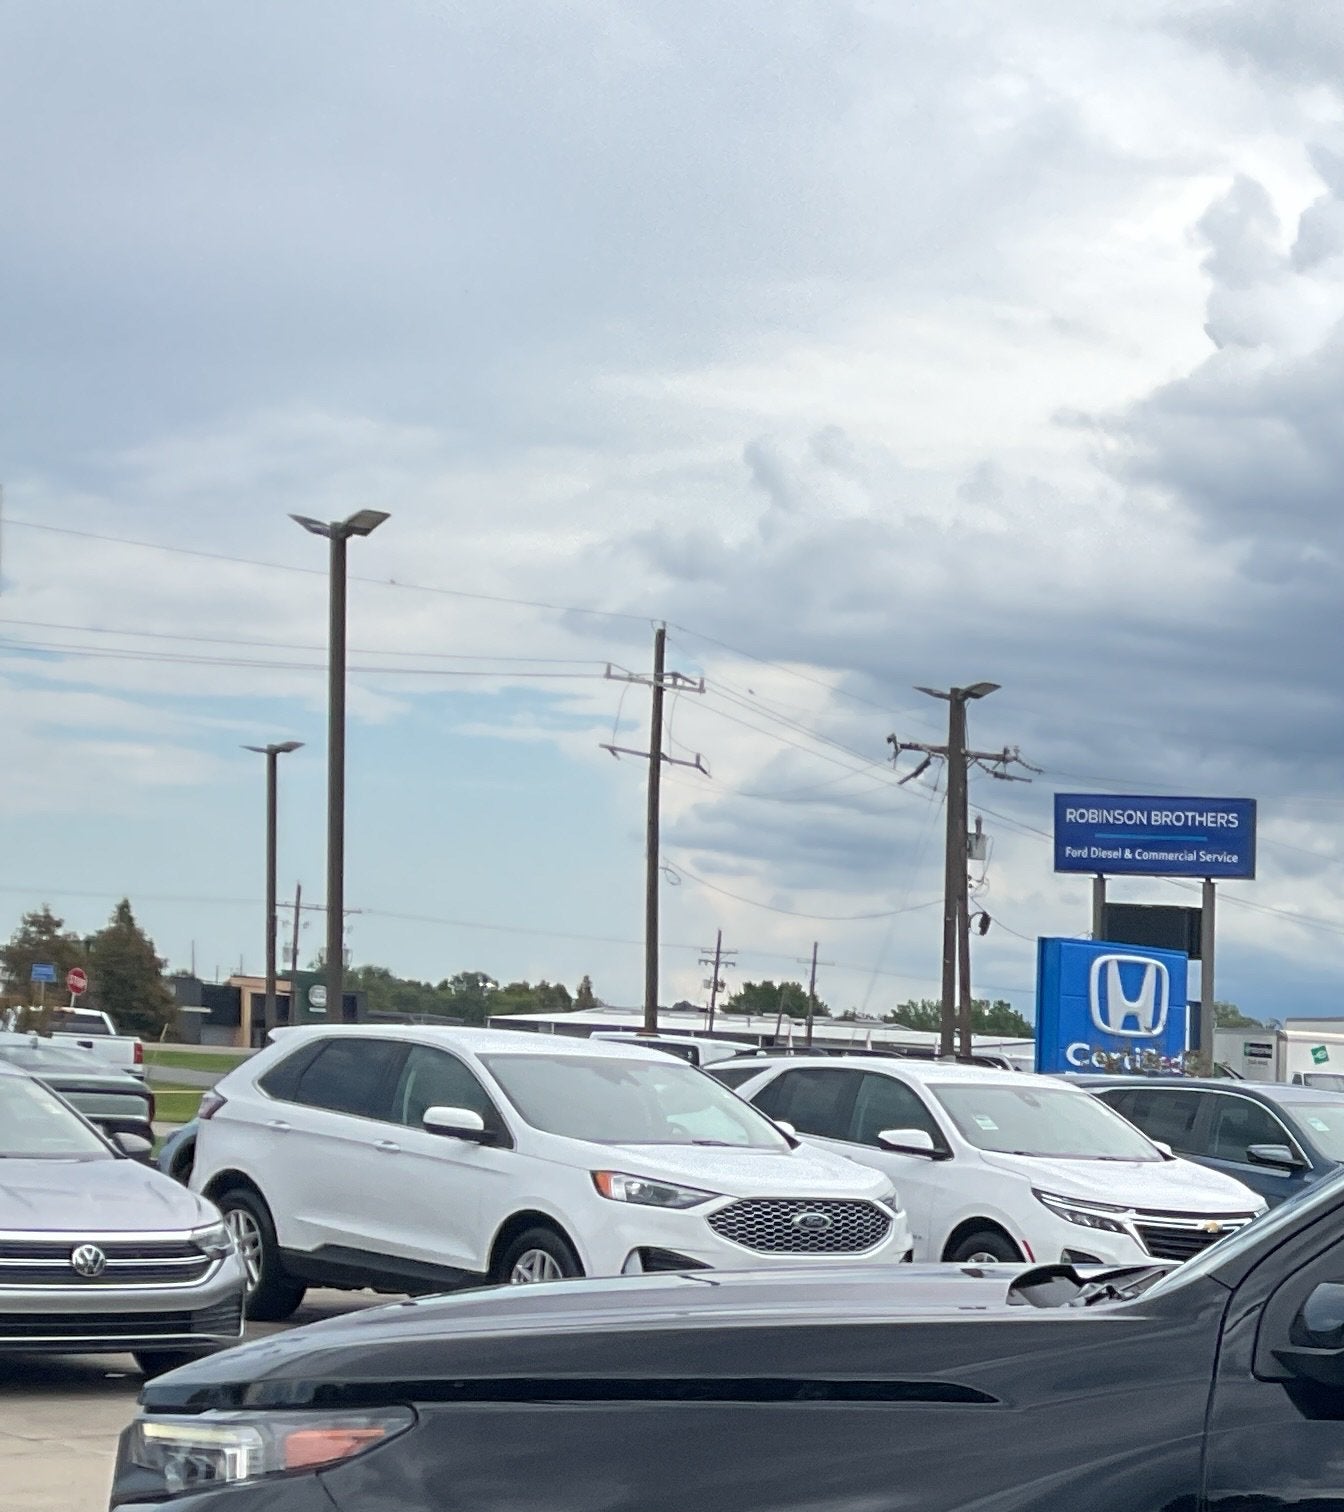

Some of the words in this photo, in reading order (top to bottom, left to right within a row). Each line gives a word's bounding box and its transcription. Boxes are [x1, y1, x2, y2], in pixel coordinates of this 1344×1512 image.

[1066, 808, 1147, 825] ROBINSON
[1151, 811, 1239, 828] BROTHERS
[1065, 846, 1088, 859] Ford
[1090, 847, 1122, 860] Diesel
[1124, 848, 1133, 860] &
[1135, 849, 1197, 862] Commercial
[1199, 851, 1239, 864] Service
